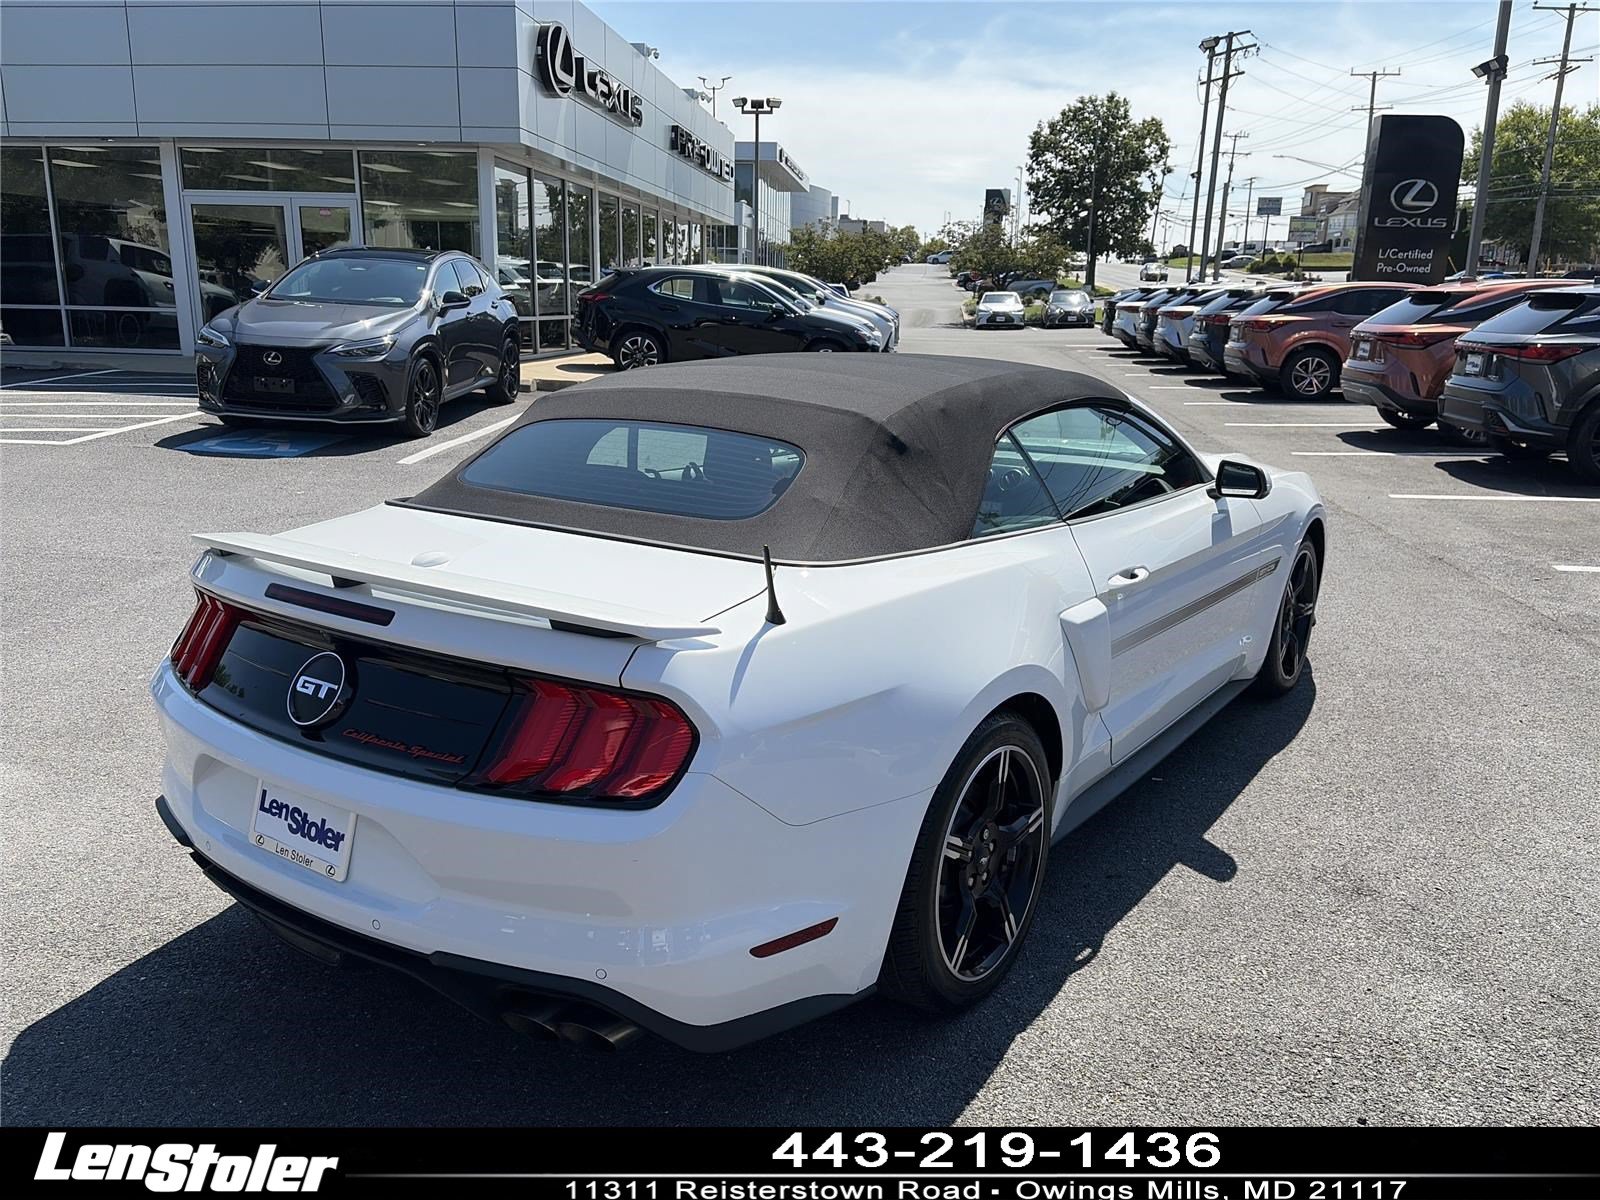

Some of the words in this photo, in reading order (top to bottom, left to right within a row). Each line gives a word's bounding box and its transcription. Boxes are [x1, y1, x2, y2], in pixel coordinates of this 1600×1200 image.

[574, 57, 643, 126] LEXUS
[1374, 217, 1447, 228] LEXUS
[1378, 249, 1433, 259] L/Certified
[1376, 263, 1431, 273] Pre-Owned
[296, 675, 338, 699] GT
[343, 728, 407, 752] California
[408, 745, 464, 764] Special
[275, 843, 290, 858] Len
[290, 849, 314, 868] Stoler
